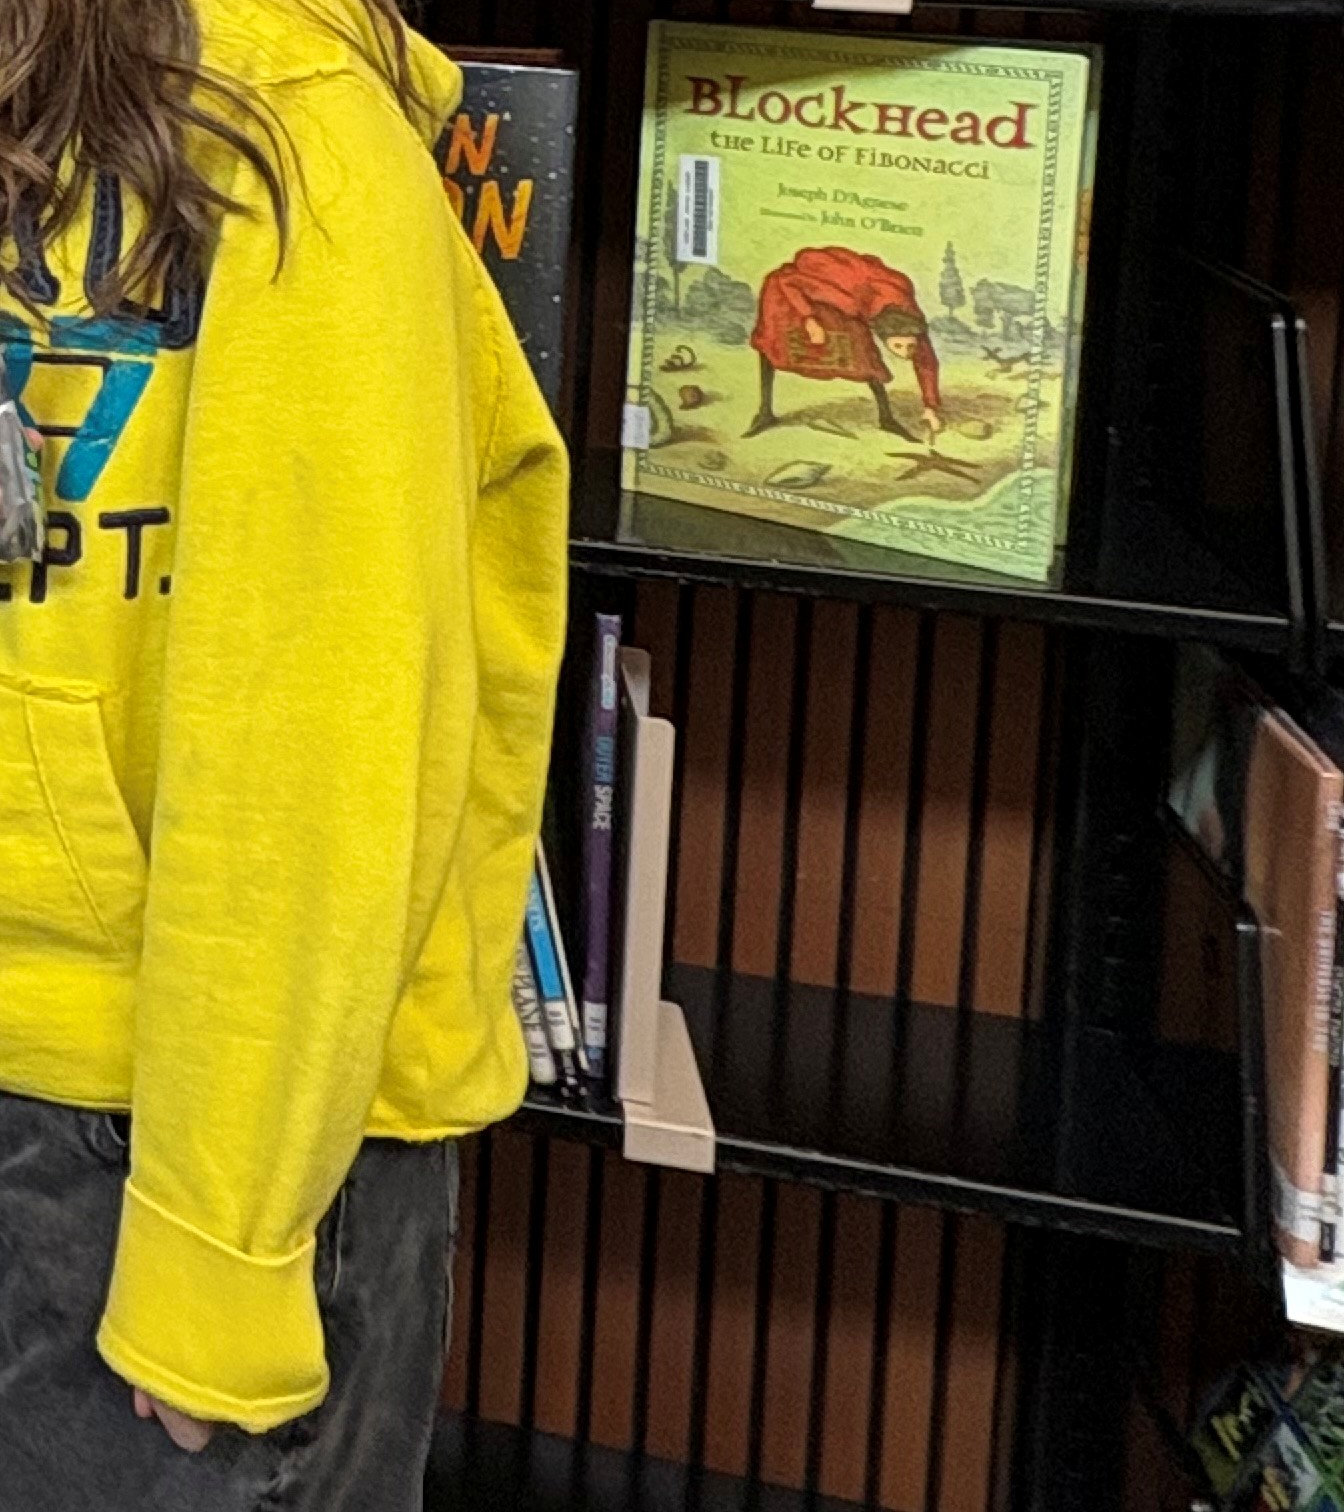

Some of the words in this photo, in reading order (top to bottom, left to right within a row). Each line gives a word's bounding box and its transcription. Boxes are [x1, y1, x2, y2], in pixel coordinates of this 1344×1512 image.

[777, 182, 828, 204] Joseph
[820, 210, 858, 230] John
[590, 784, 613, 830] SPACE
